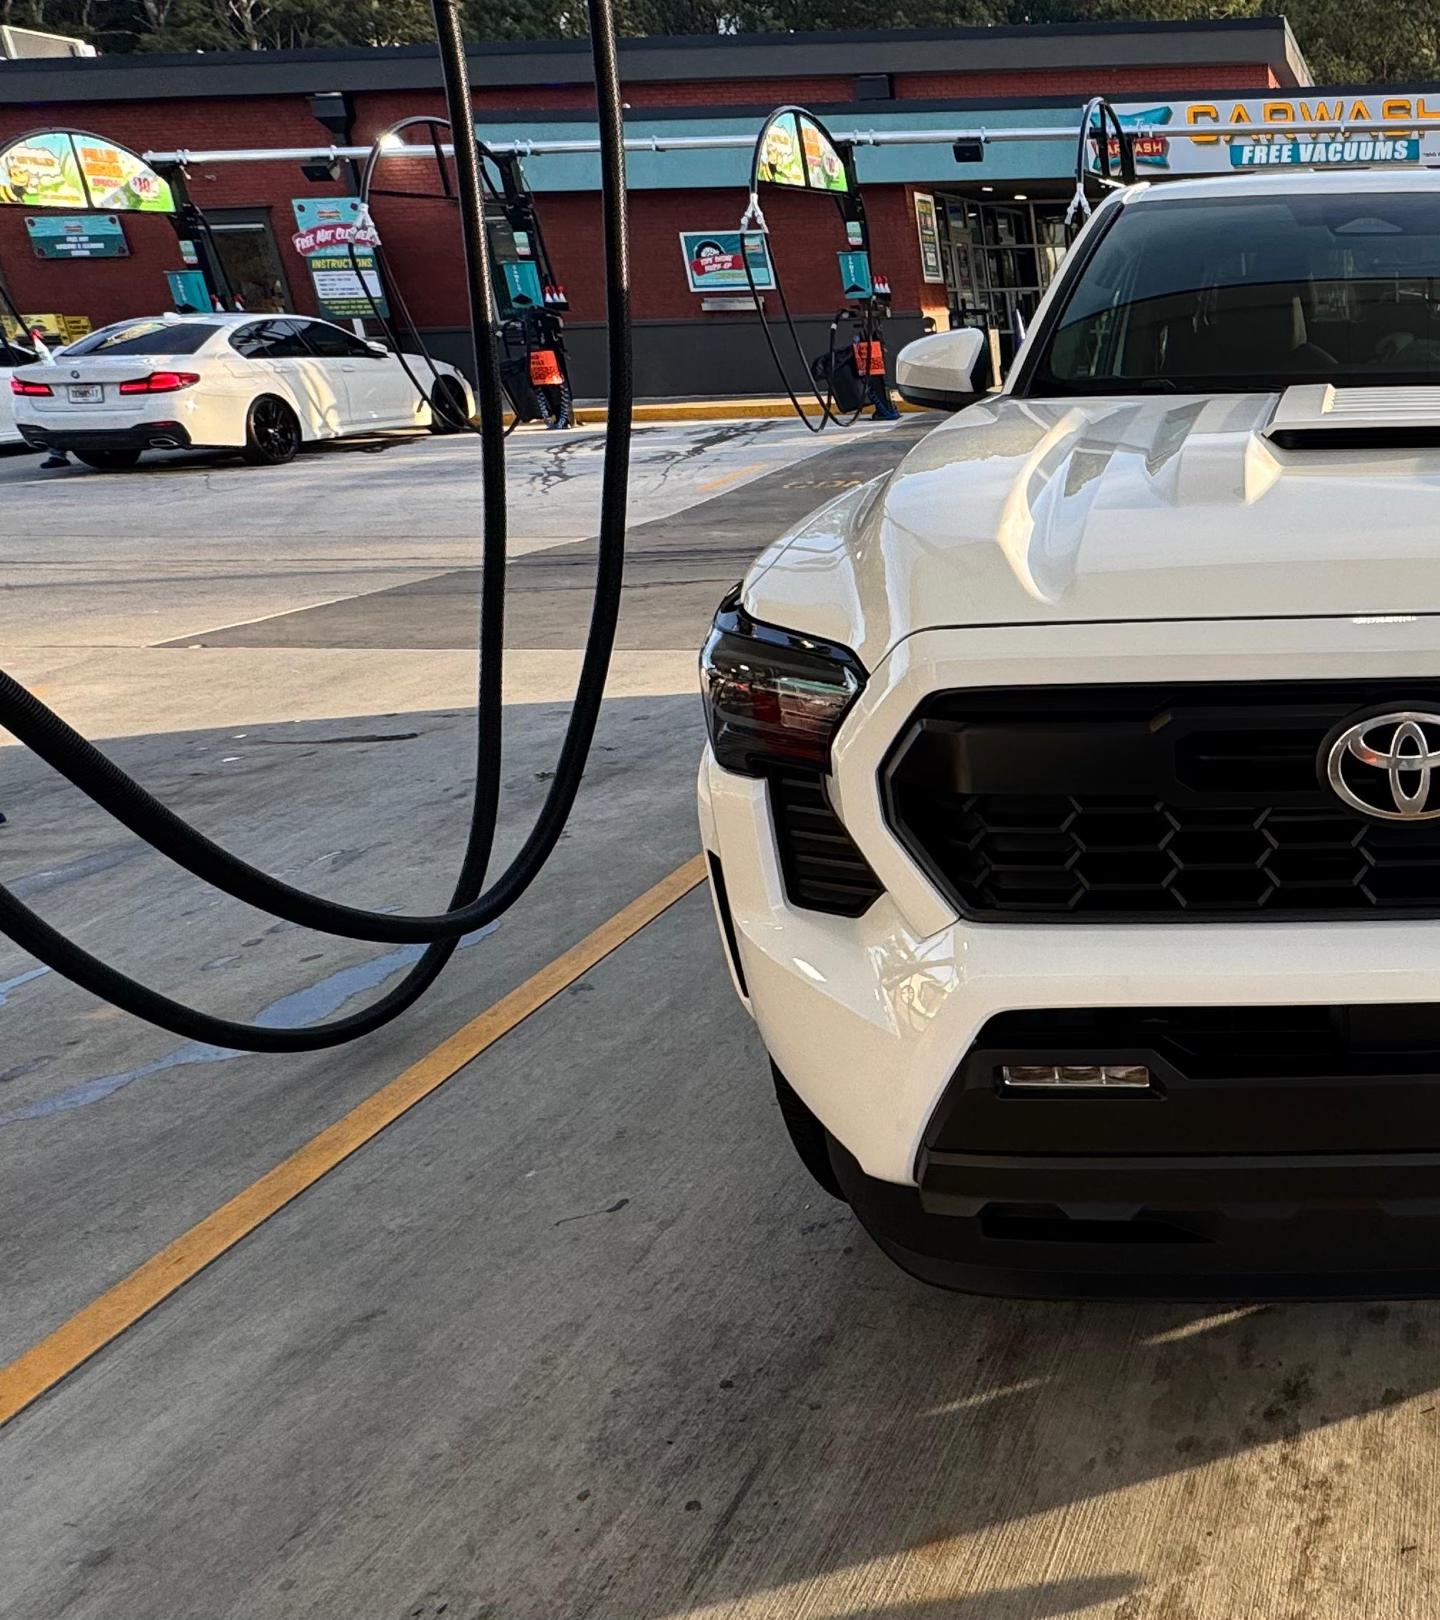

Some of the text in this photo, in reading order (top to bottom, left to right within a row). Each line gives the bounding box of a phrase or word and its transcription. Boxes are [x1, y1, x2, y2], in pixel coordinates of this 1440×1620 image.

[1241, 140, 1409, 165] FREE VACUUMS
[312, 258, 373, 269] INSTRUCTONS
